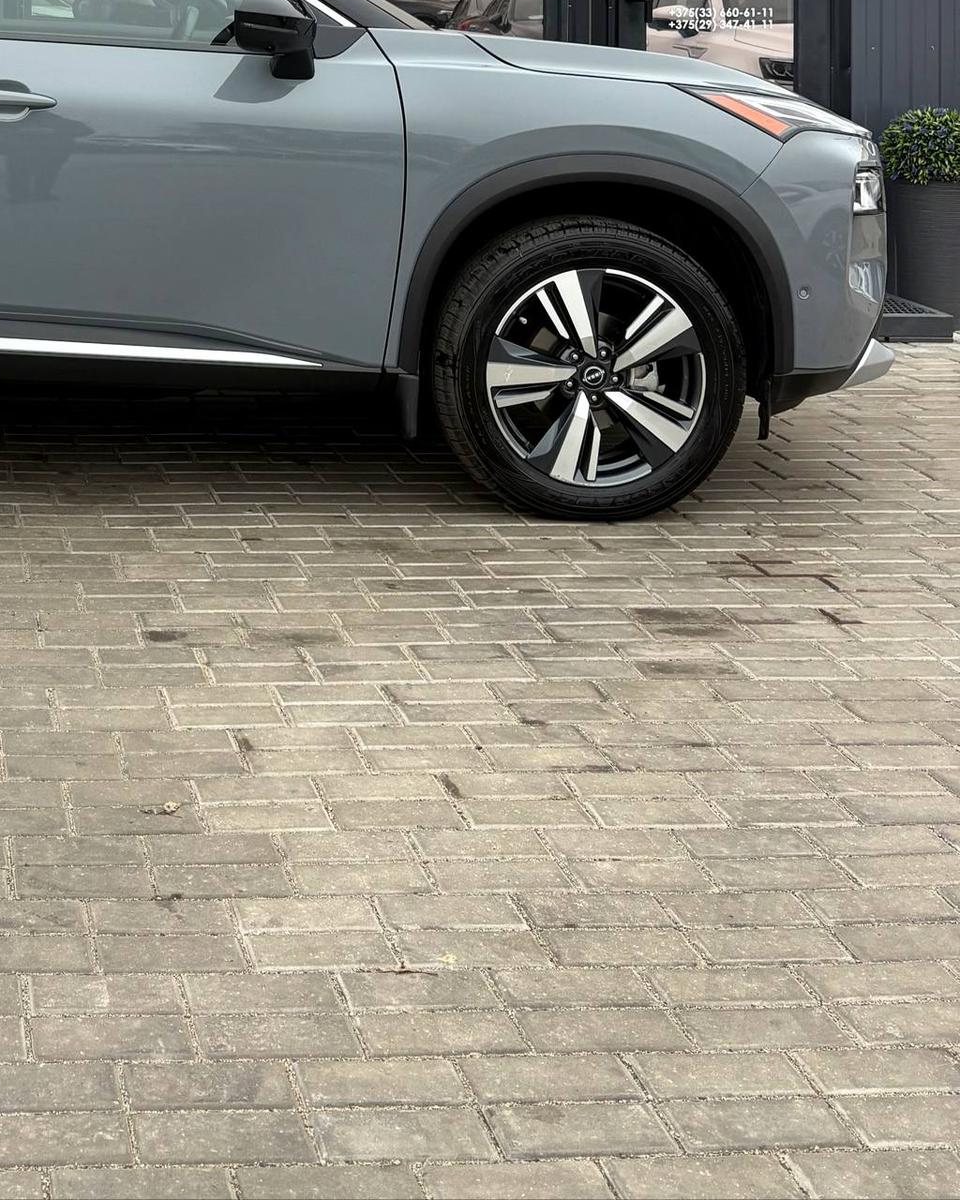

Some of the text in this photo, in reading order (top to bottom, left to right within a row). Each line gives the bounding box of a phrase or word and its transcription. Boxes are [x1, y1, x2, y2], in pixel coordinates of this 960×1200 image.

[669, 7, 773, 20] +375(33) 660-61-11
[668, 19, 717, 32] +375(29)
